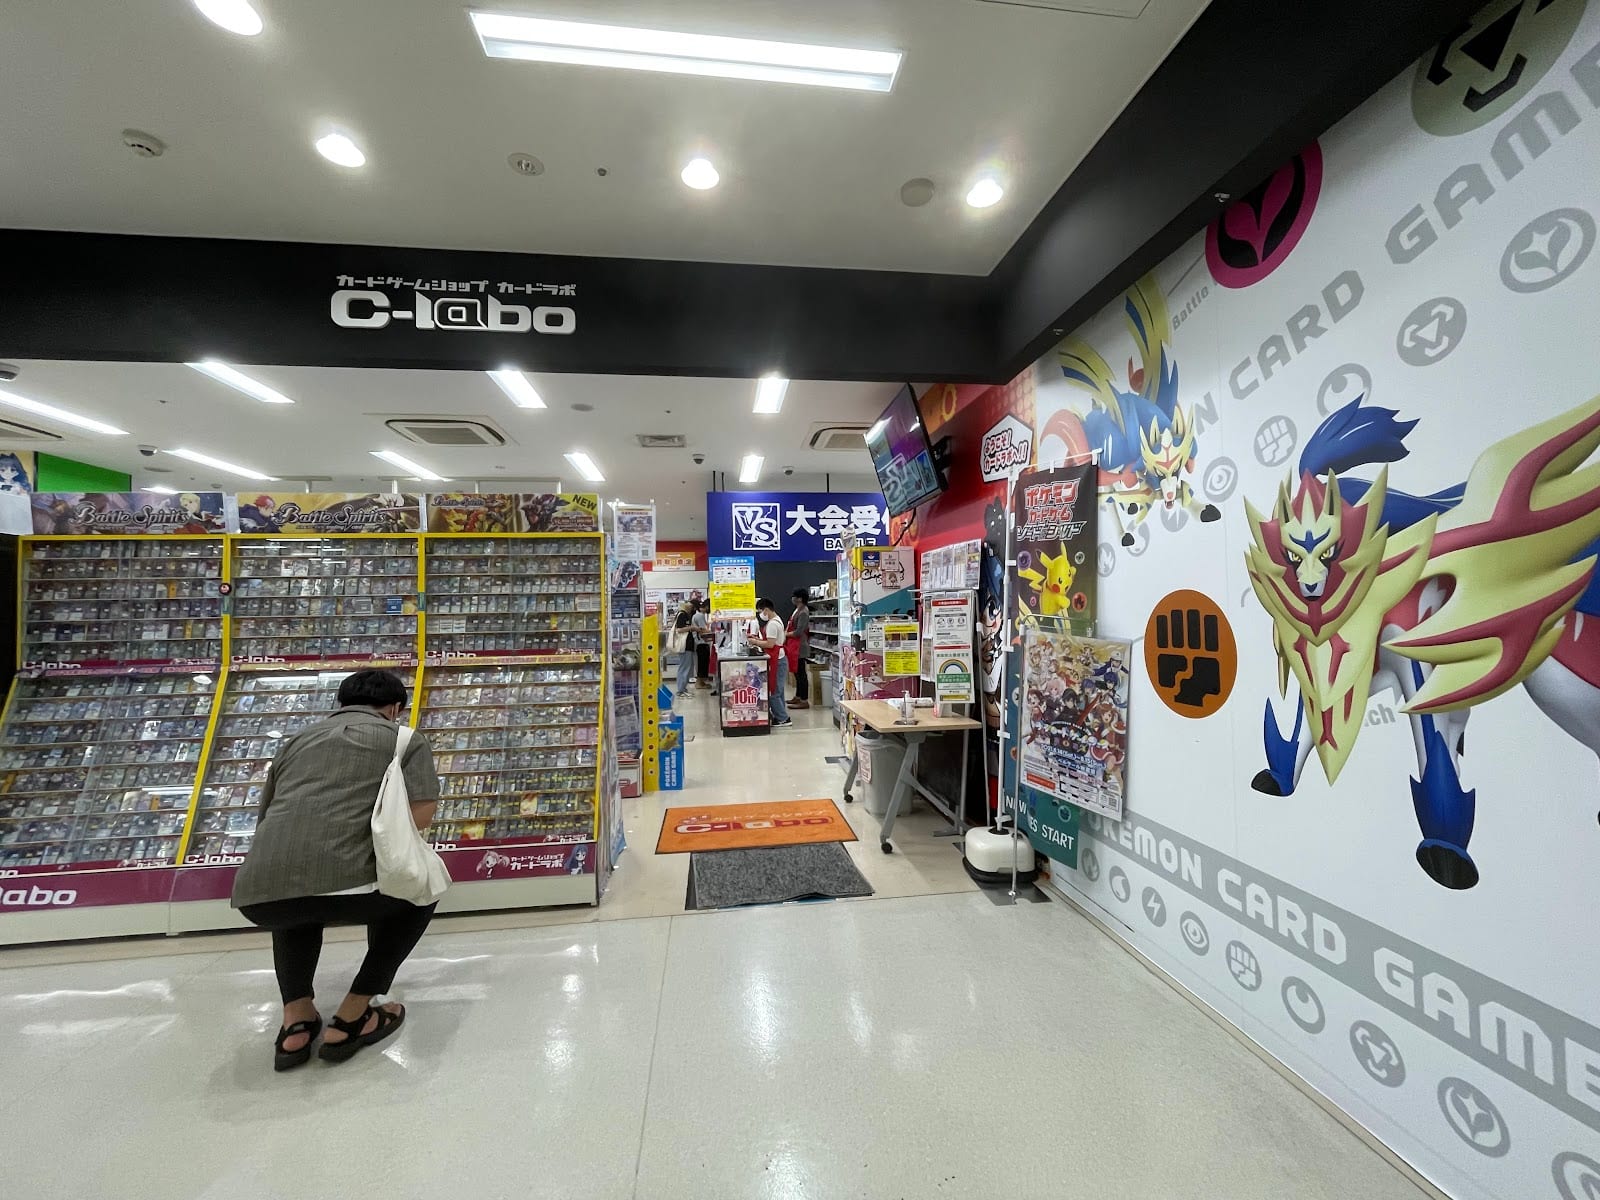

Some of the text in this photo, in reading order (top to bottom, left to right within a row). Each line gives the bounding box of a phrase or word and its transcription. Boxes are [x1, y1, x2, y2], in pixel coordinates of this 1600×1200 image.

[337, 274, 577, 296] カードゲームショップ カードラボ
[1172, 286, 1209, 331] Battle
[1228, 270, 1365, 400] CARD
[573, 494, 598, 511] NEW
[1025, 480, 1080, 507] ポケモン
[70, 502, 190, 528] Battle Spirits
[273, 503, 386, 529] Battle Spirits
[1042, 824, 1074, 850] START
[510, 859, 564, 870] カードラボ
[1217, 867, 1347, 965] CARD
